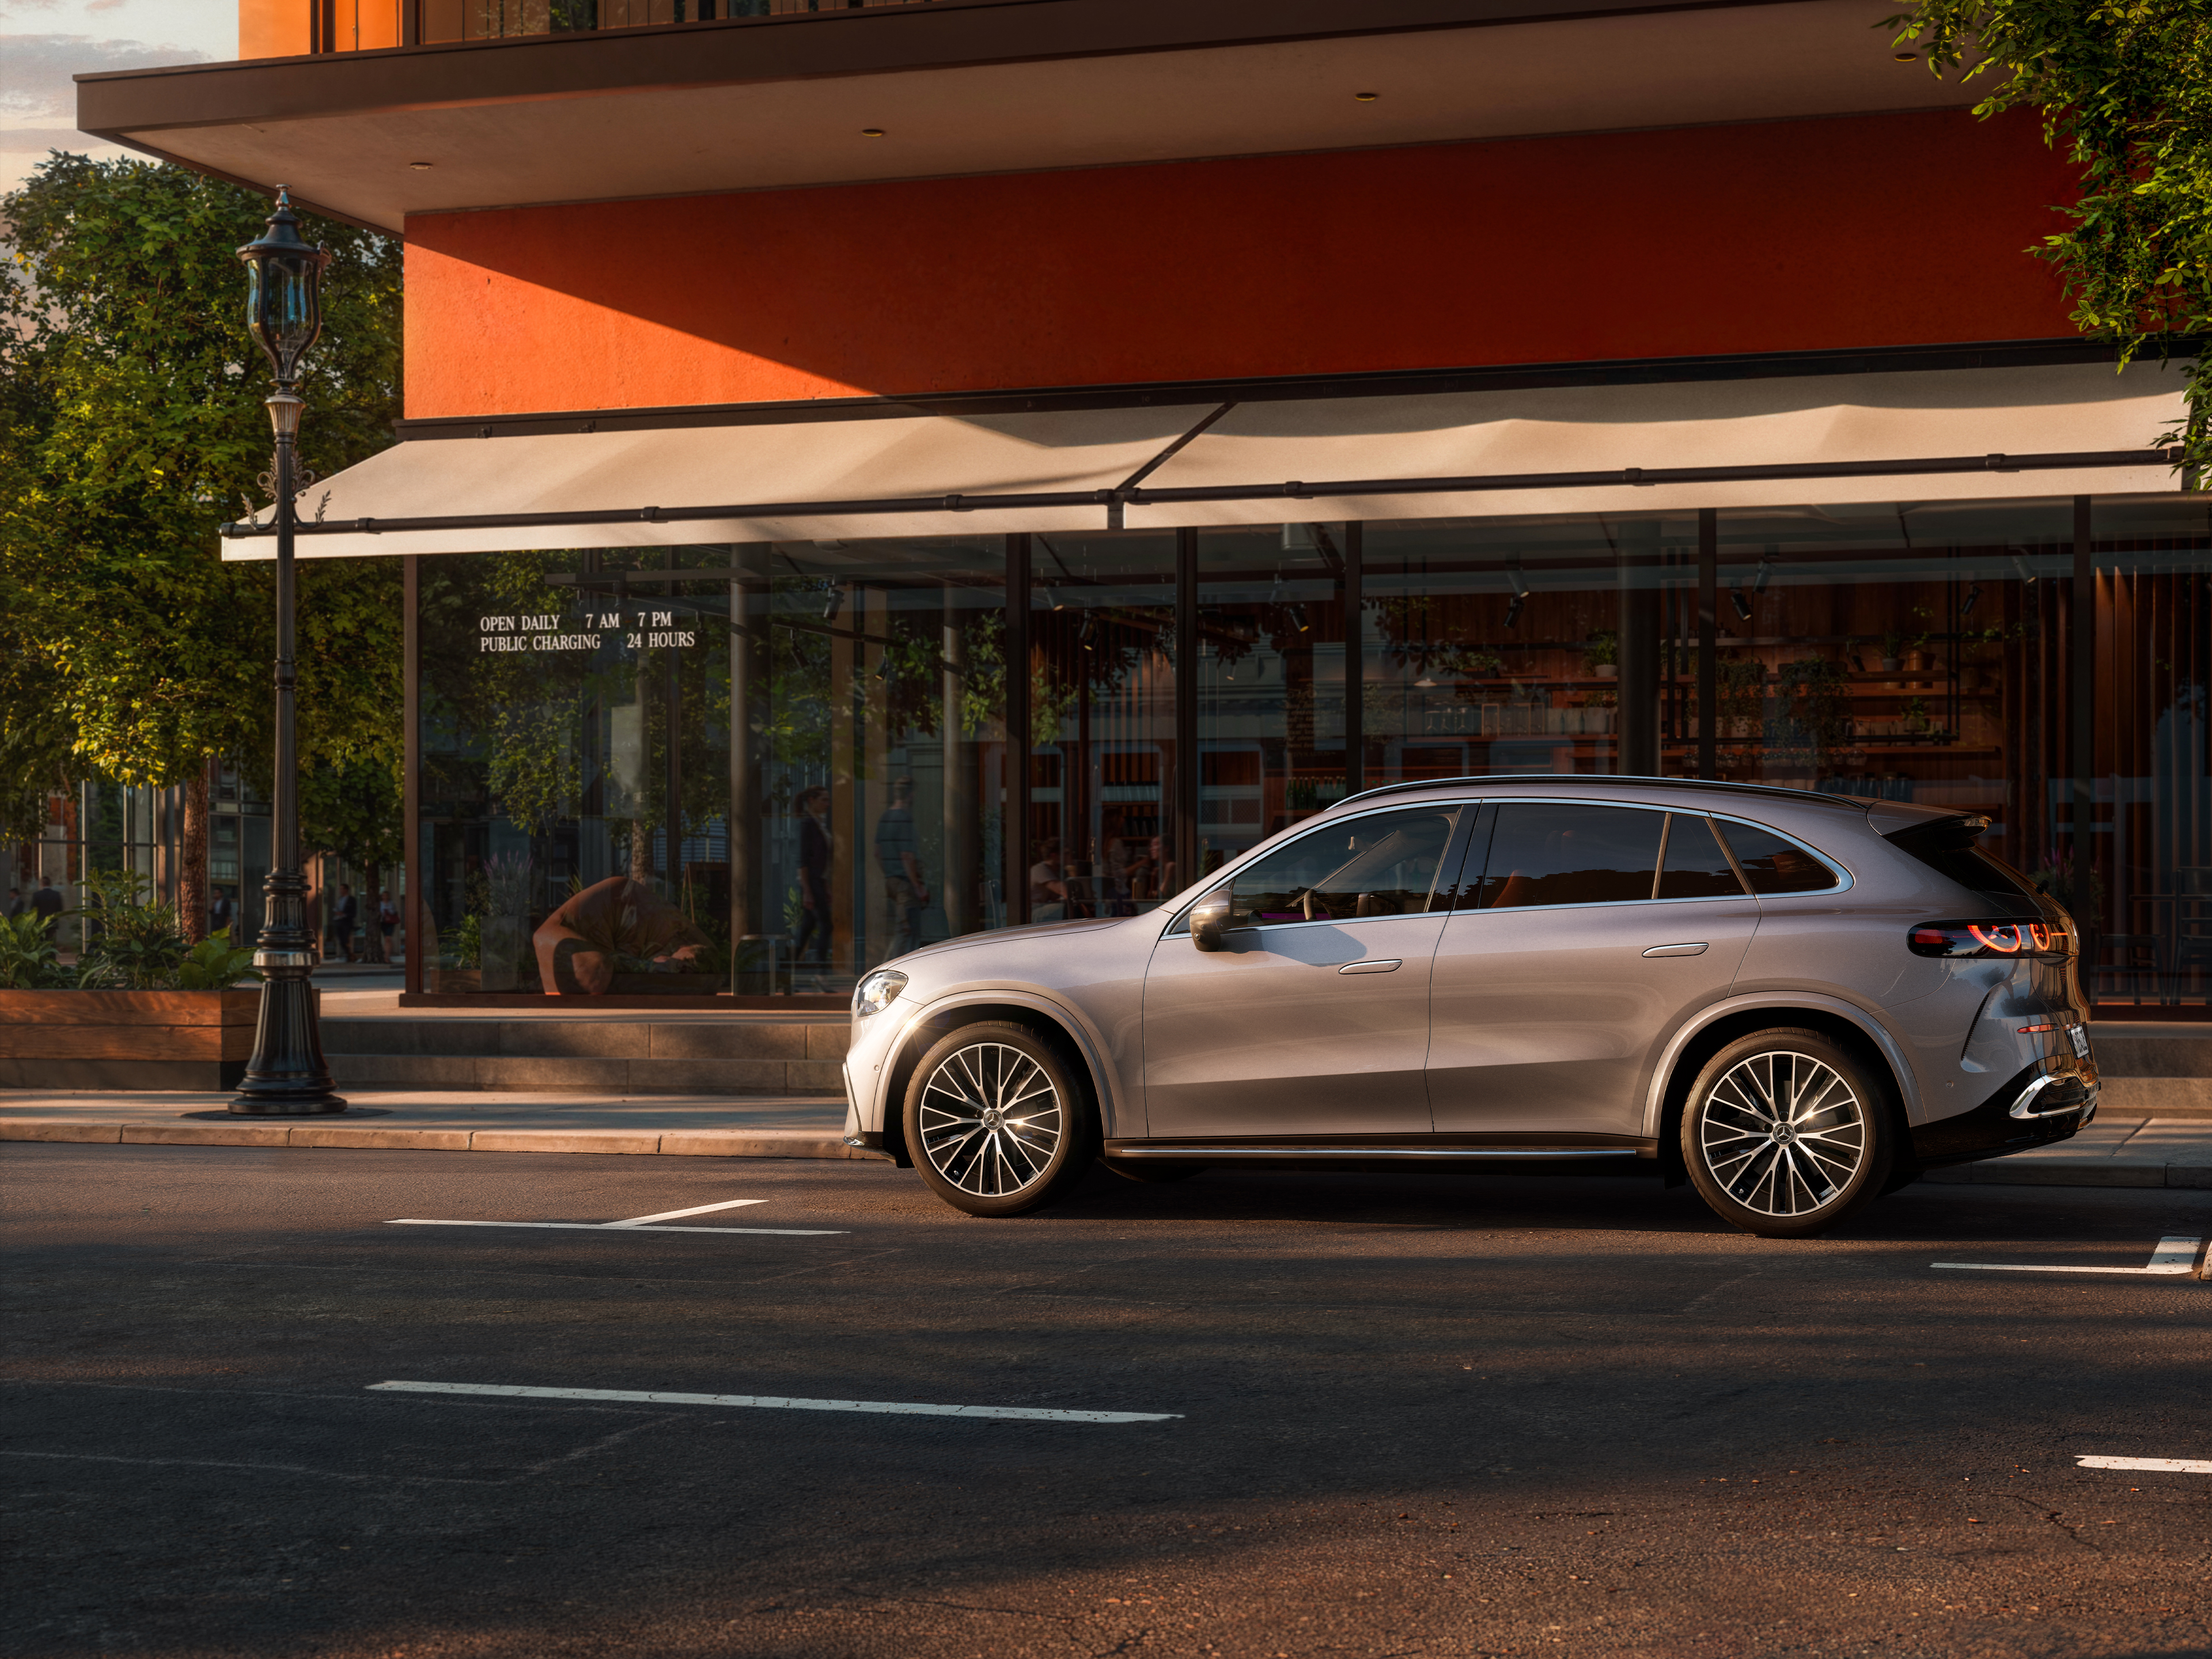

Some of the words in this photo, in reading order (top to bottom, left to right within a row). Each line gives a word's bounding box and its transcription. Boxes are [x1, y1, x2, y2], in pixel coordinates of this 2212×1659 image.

[480, 616, 515, 631] OPEN
[521, 615, 560, 631] DAILY
[585, 613, 593, 628] 7
[599, 613, 620, 628] AM
[638, 612, 646, 627] 7
[652, 611, 672, 627] PM
[480, 636, 527, 652] PUBLIC
[533, 634, 601, 650] CHARGING
[627, 633, 642, 648] 24
[649, 631, 695, 647] HOURS
